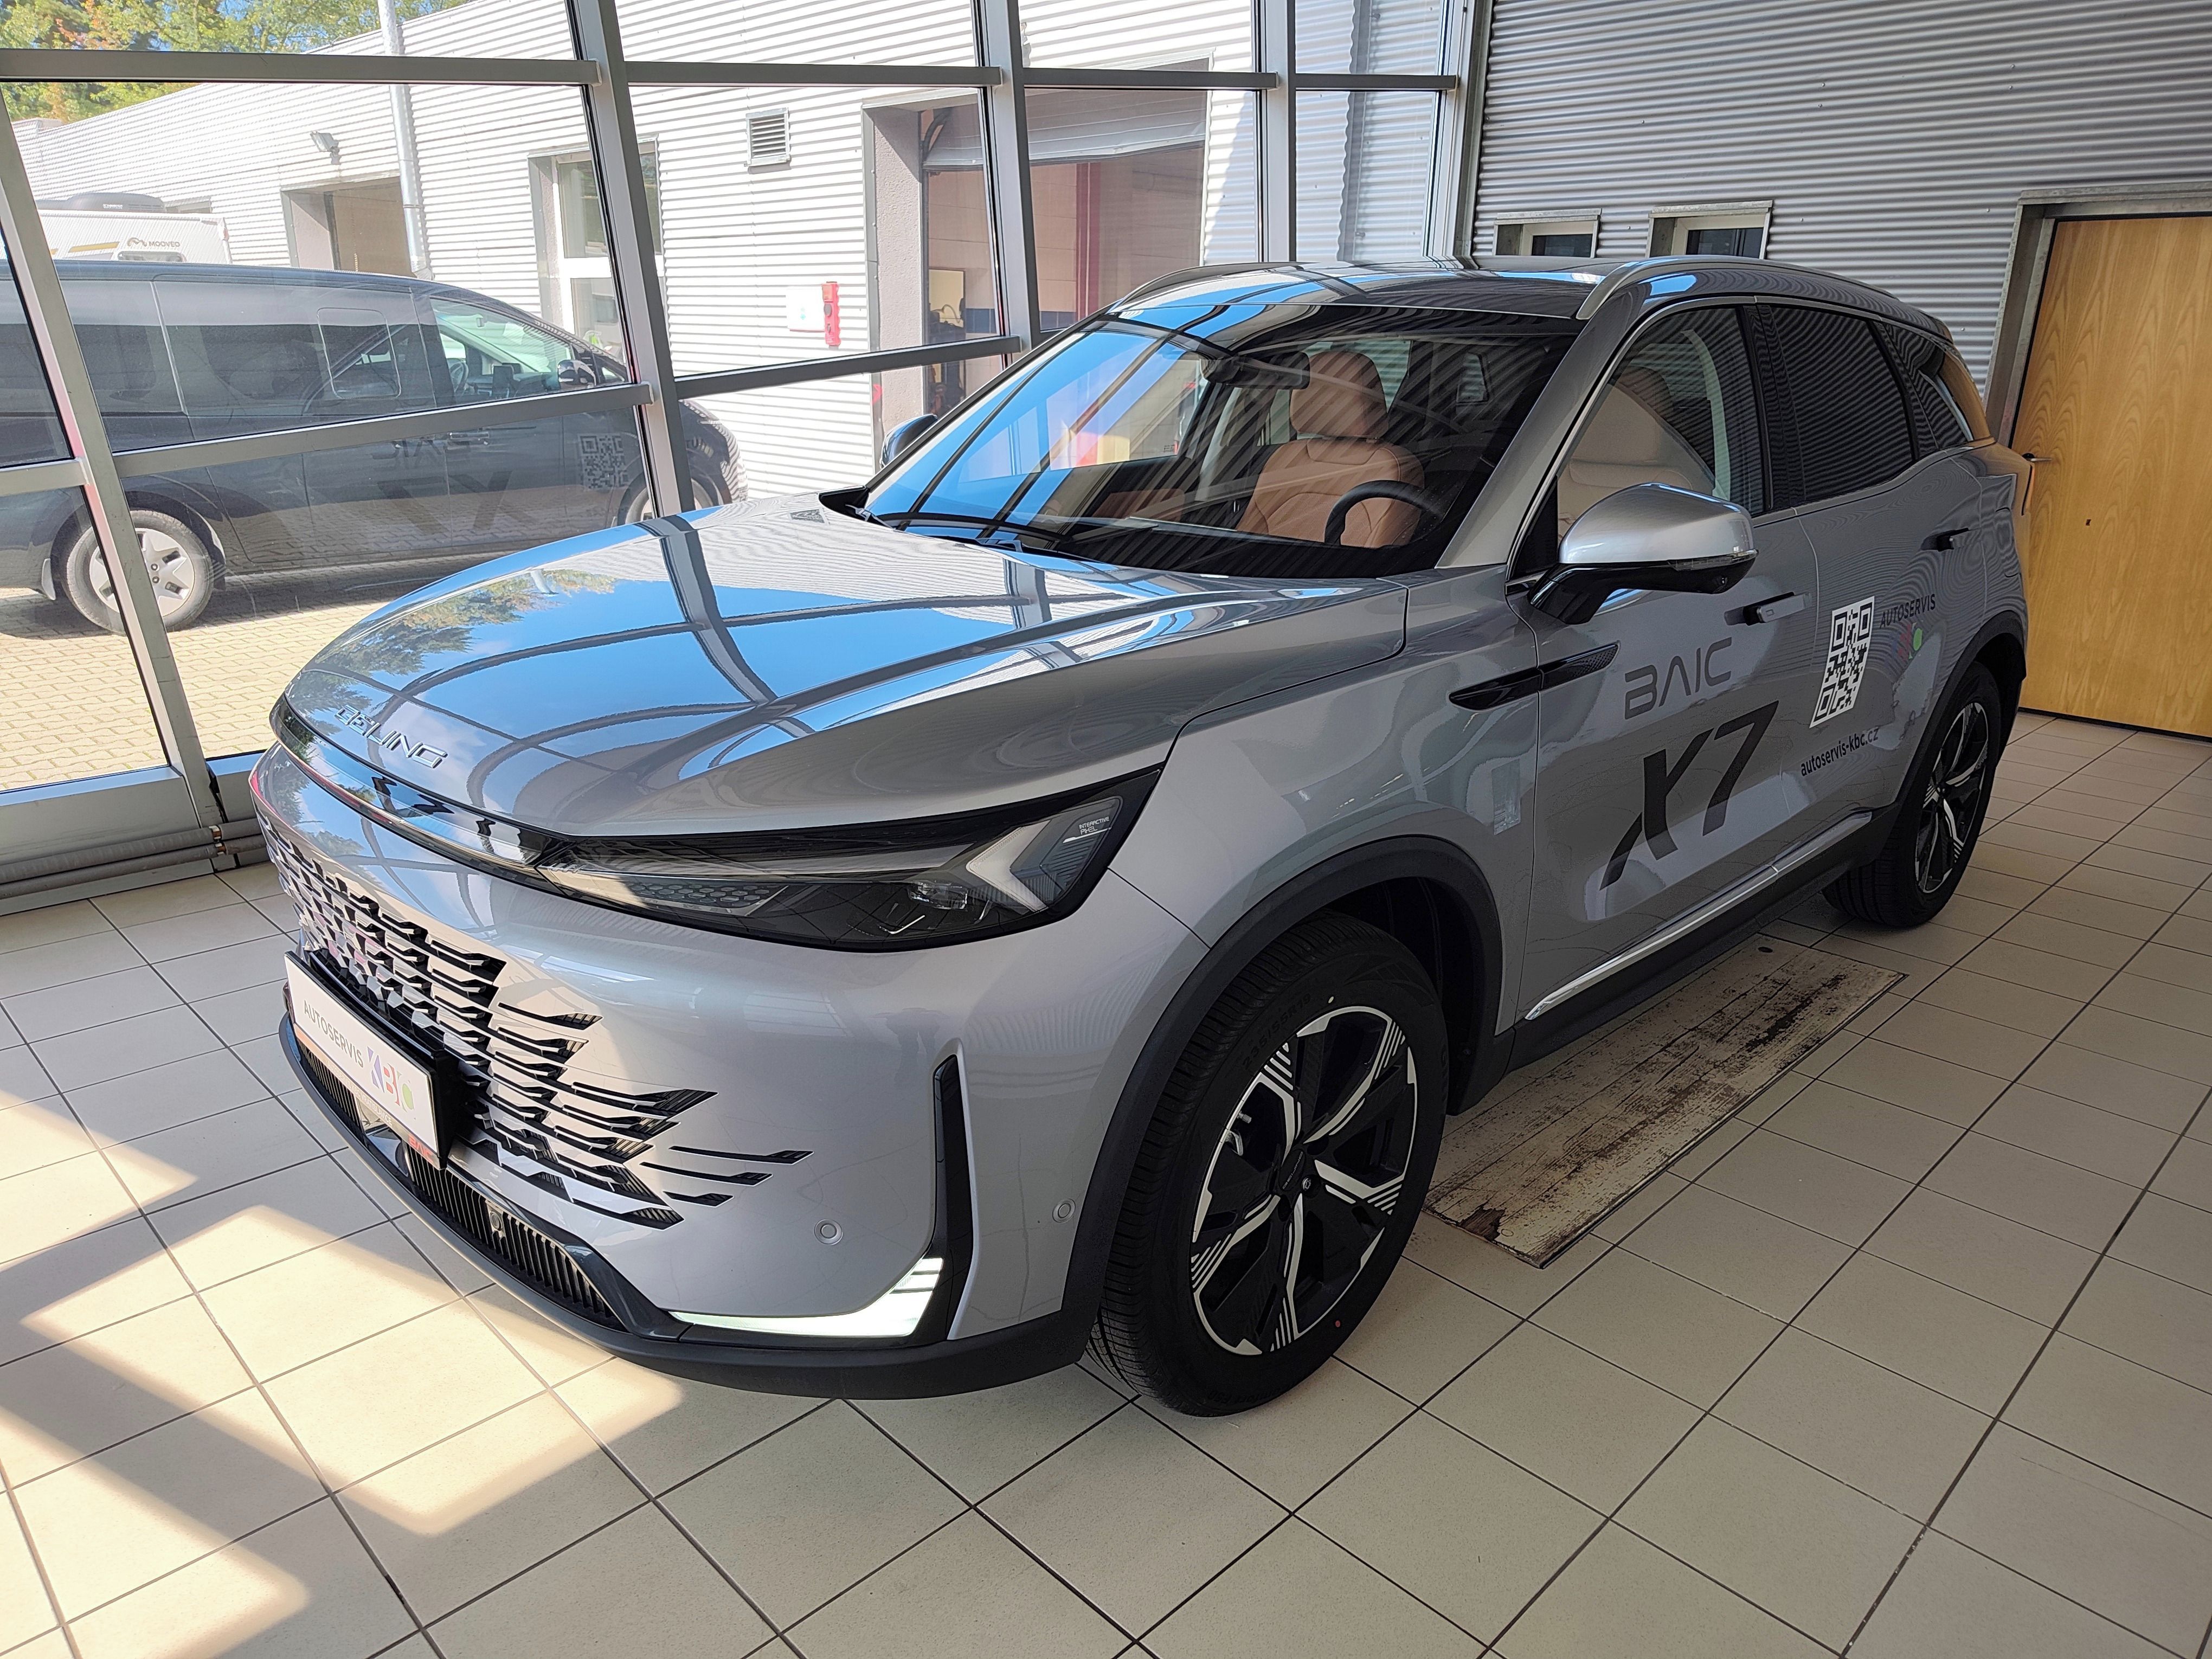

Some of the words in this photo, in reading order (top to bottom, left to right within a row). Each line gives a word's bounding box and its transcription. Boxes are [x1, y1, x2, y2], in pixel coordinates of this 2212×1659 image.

[1879, 594, 1936, 629] AUTOSERVIS
[1625, 636, 1732, 719] BAIC
[1801, 728, 1880, 776] autoservis-kbc.cz
[1599, 700, 1779, 891] X7
[1079, 816, 1110, 829] INTERACTIVE
[304, 999, 364, 1068] AUTOSERVIS
[367, 1045, 416, 1114] KBC
[408, 1133, 434, 1164] BAIC
